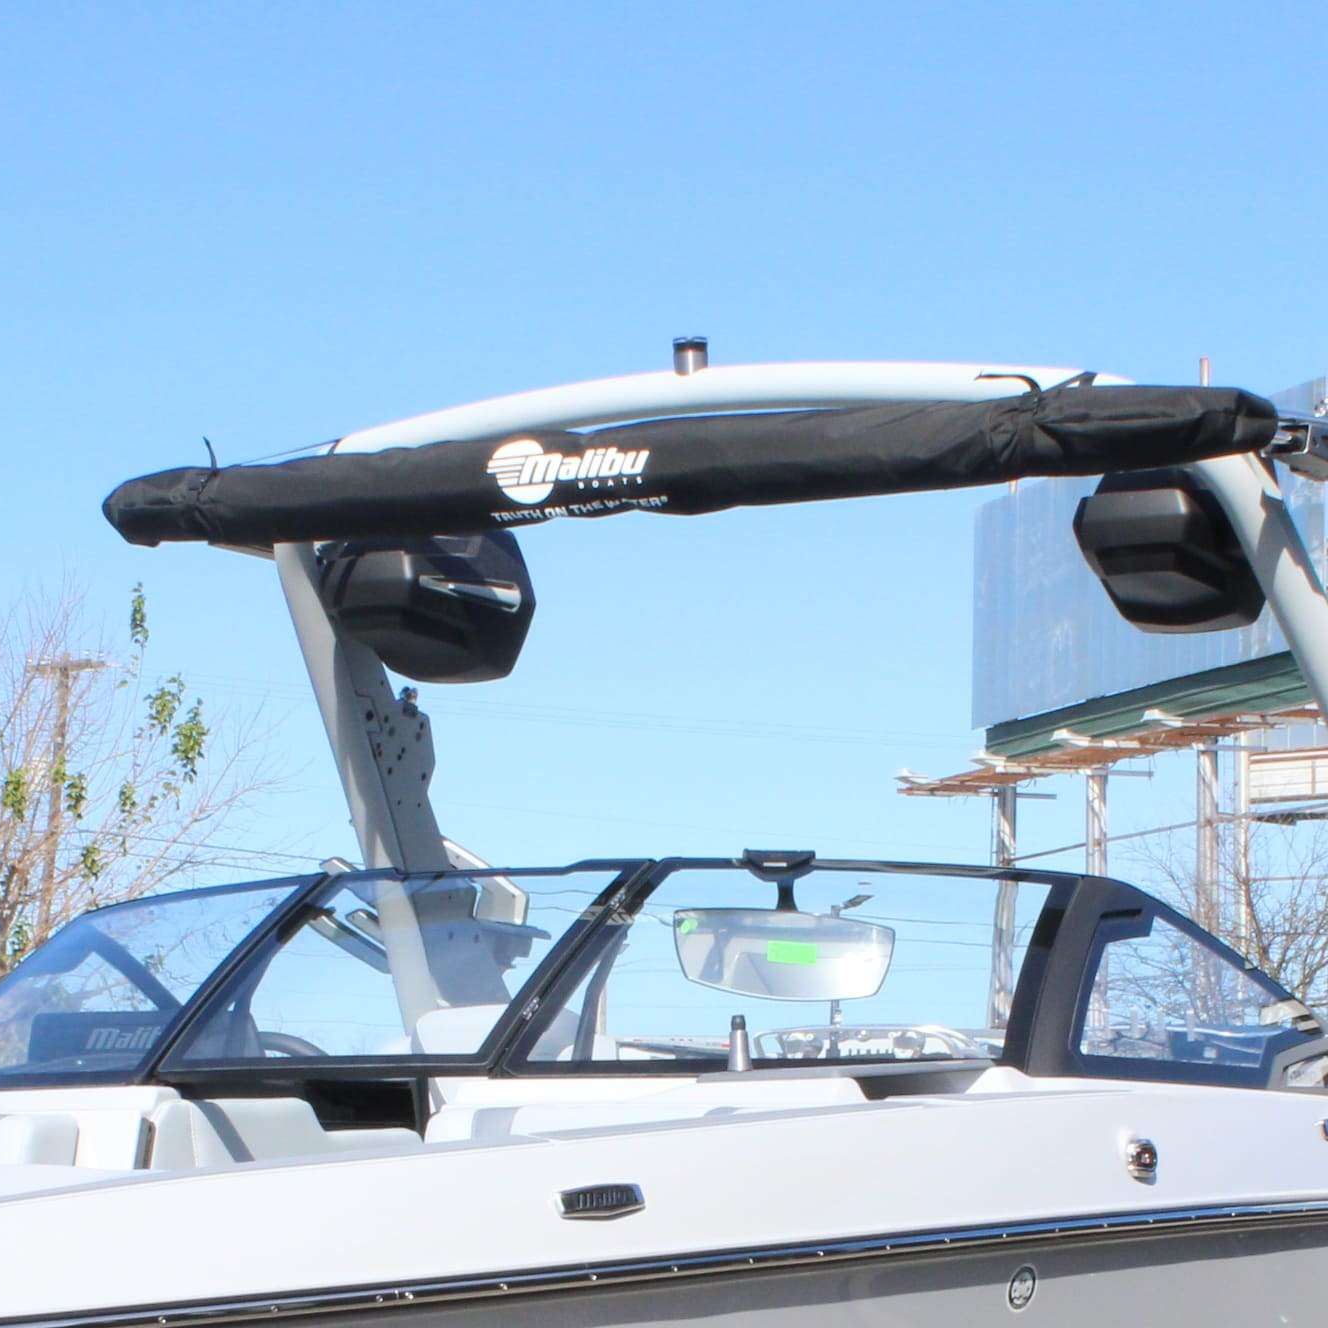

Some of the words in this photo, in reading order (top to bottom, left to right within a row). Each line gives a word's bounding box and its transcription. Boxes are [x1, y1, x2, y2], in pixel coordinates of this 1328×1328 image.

[519, 447, 650, 485] Malibu
[578, 476, 643, 490] BOATS
[490, 508, 542, 523] TRUTH
[544, 505, 568, 519] ON
[569, 500, 604, 516] THE
